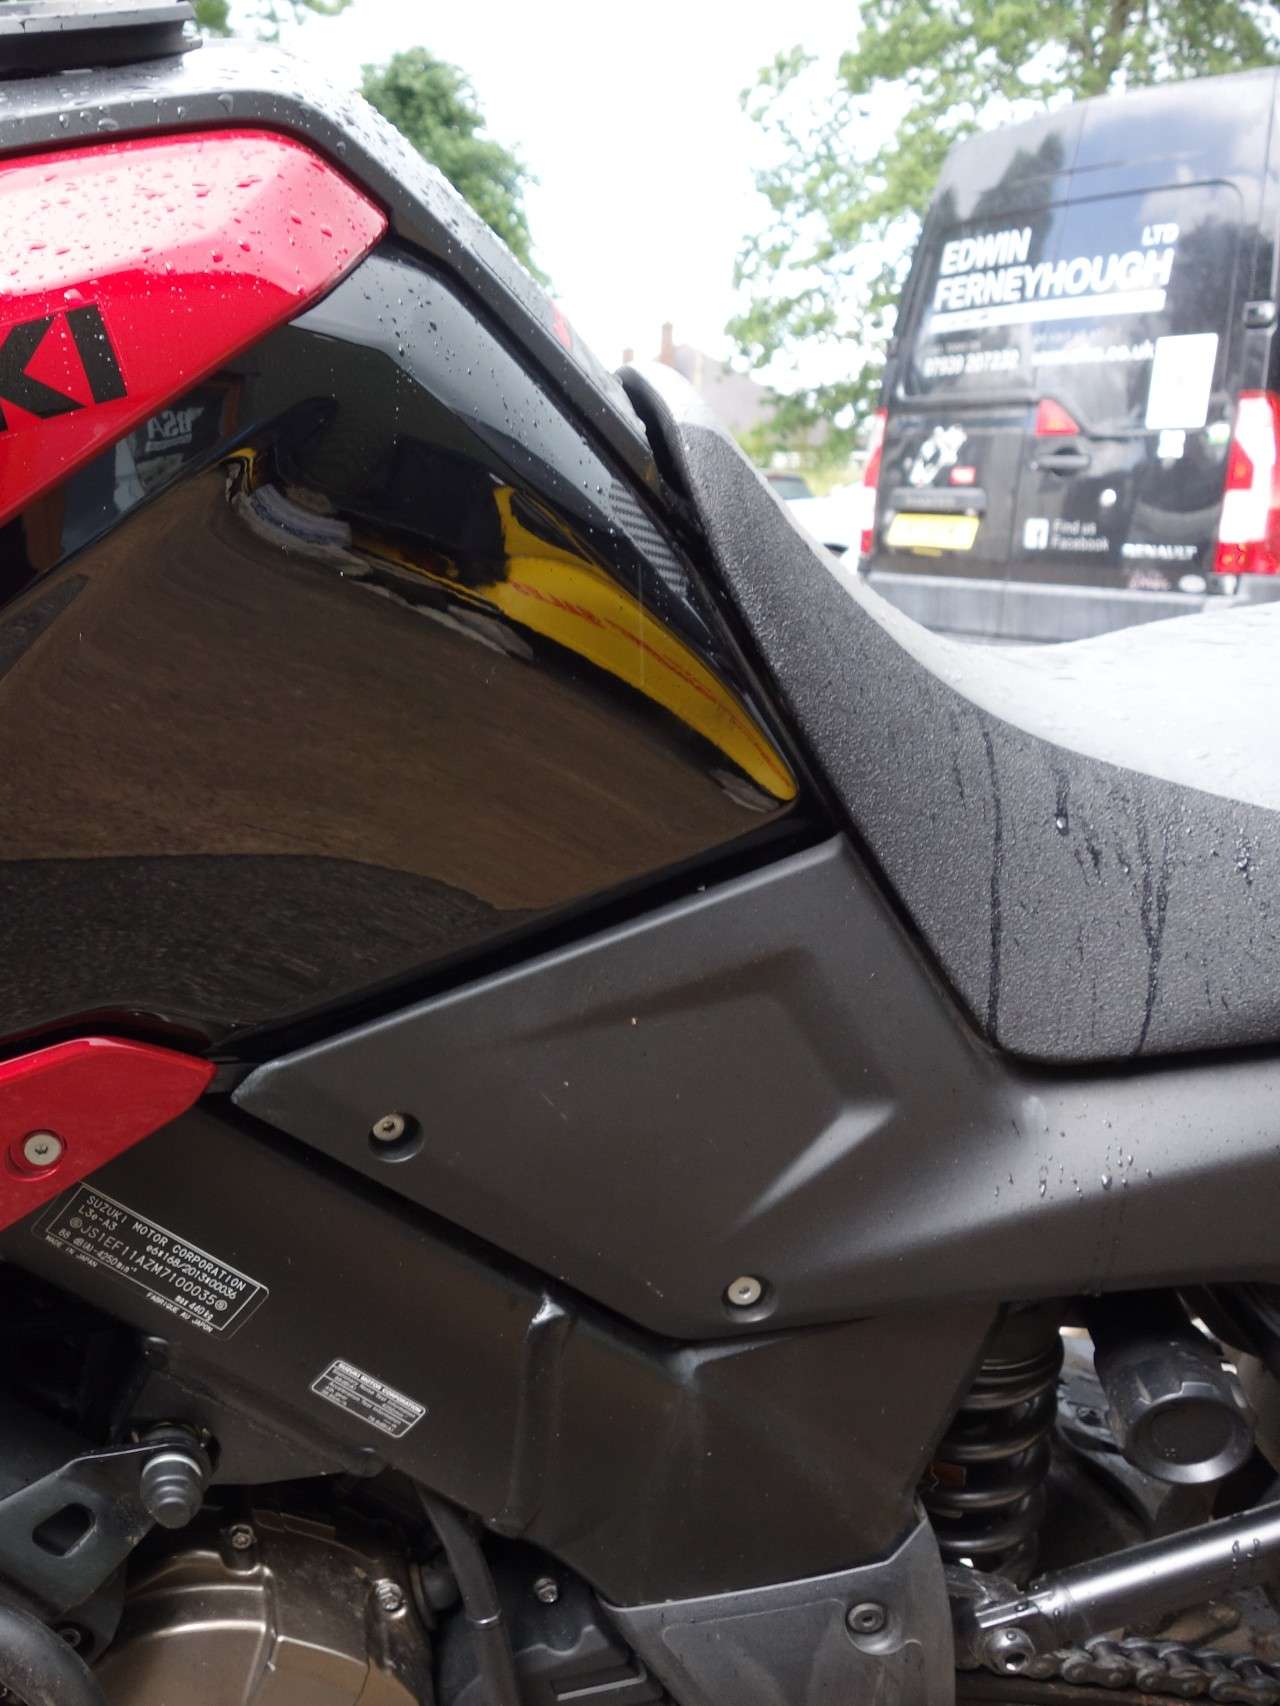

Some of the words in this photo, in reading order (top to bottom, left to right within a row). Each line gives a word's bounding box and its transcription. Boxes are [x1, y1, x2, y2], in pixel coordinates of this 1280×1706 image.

[939, 226, 1033, 277] EDWIN
[1141, 222, 1180, 247] LTD
[931, 247, 1176, 313] FERNEYHOUGH
[86, 1195, 128, 1224] SUZUKI
[132, 1221, 169, 1247] MOTOR
[172, 1243, 247, 1292] CORPORATION
